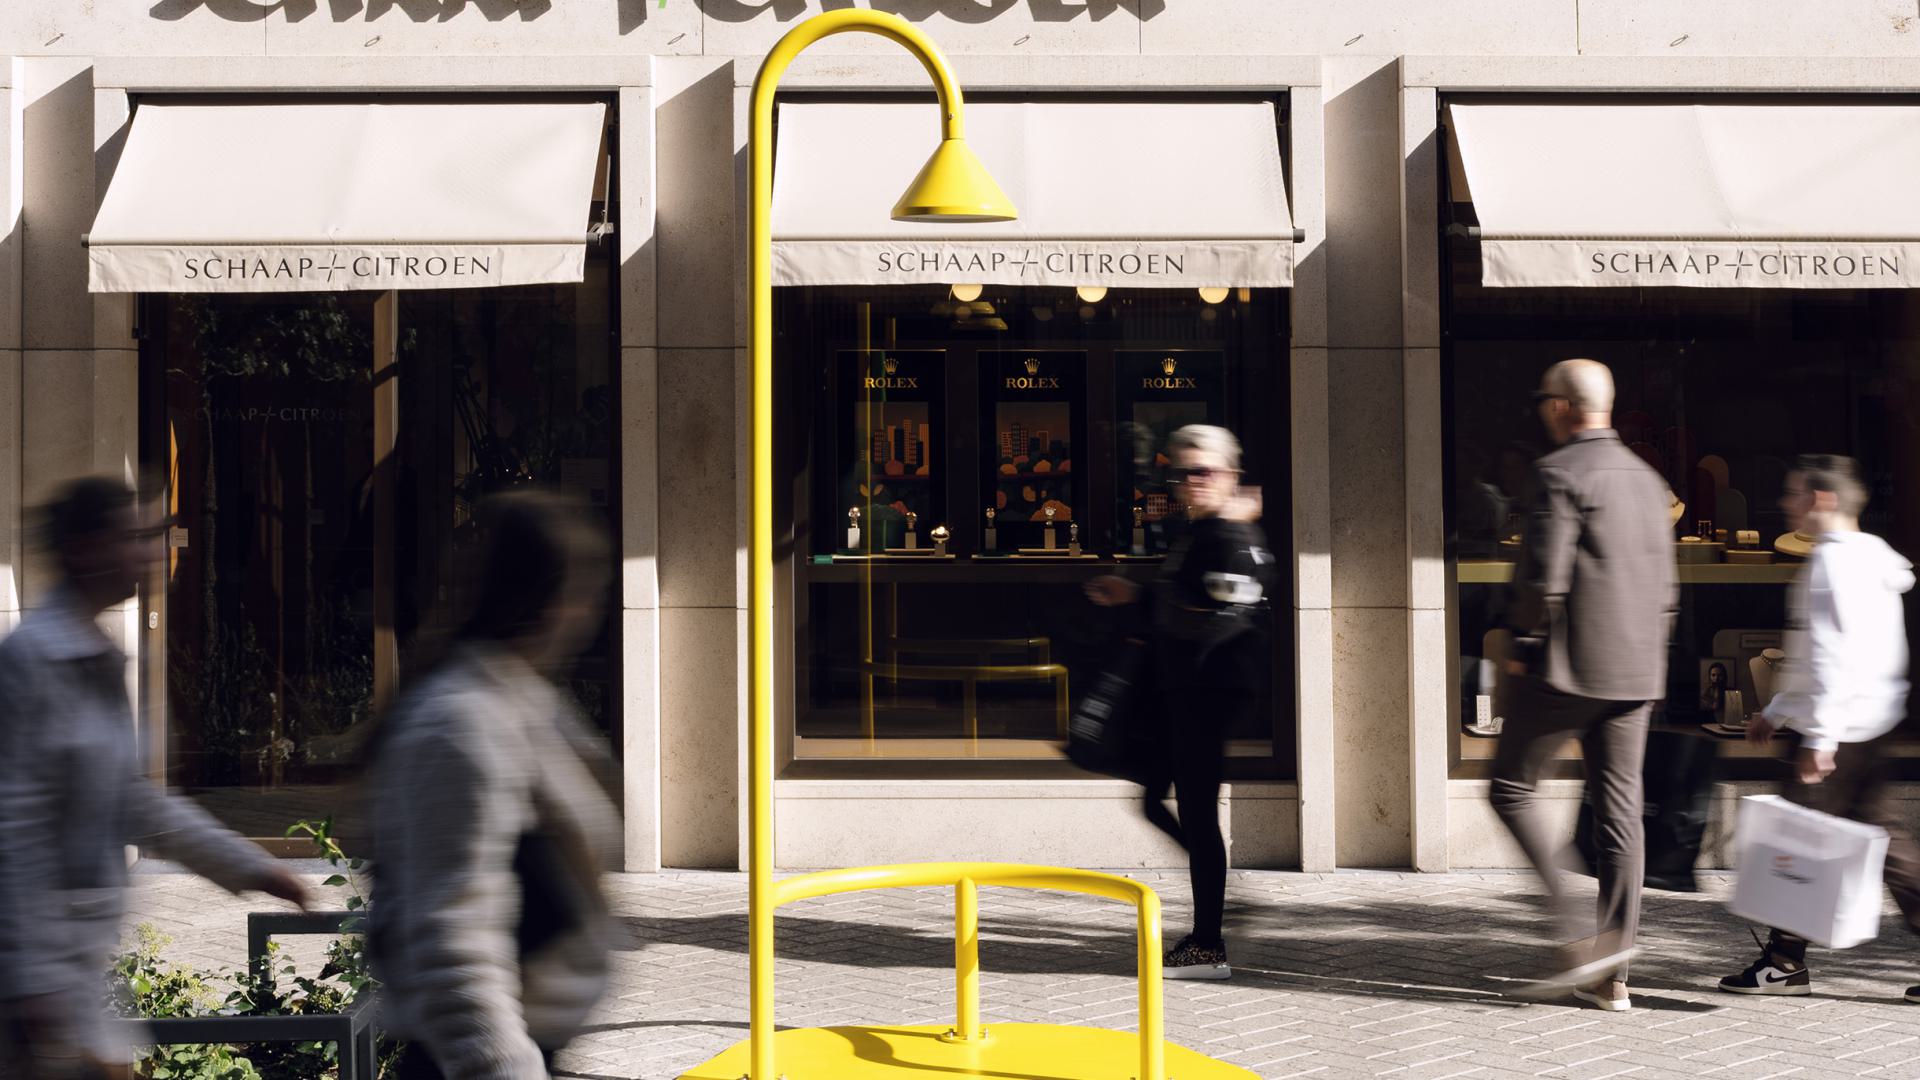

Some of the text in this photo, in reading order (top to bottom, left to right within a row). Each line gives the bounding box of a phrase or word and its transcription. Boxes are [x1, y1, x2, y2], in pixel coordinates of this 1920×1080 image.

[864, 377, 918, 389] ROLEX
[1006, 377, 1060, 389] ROLEX
[1143, 377, 1197, 389] ROLEX
